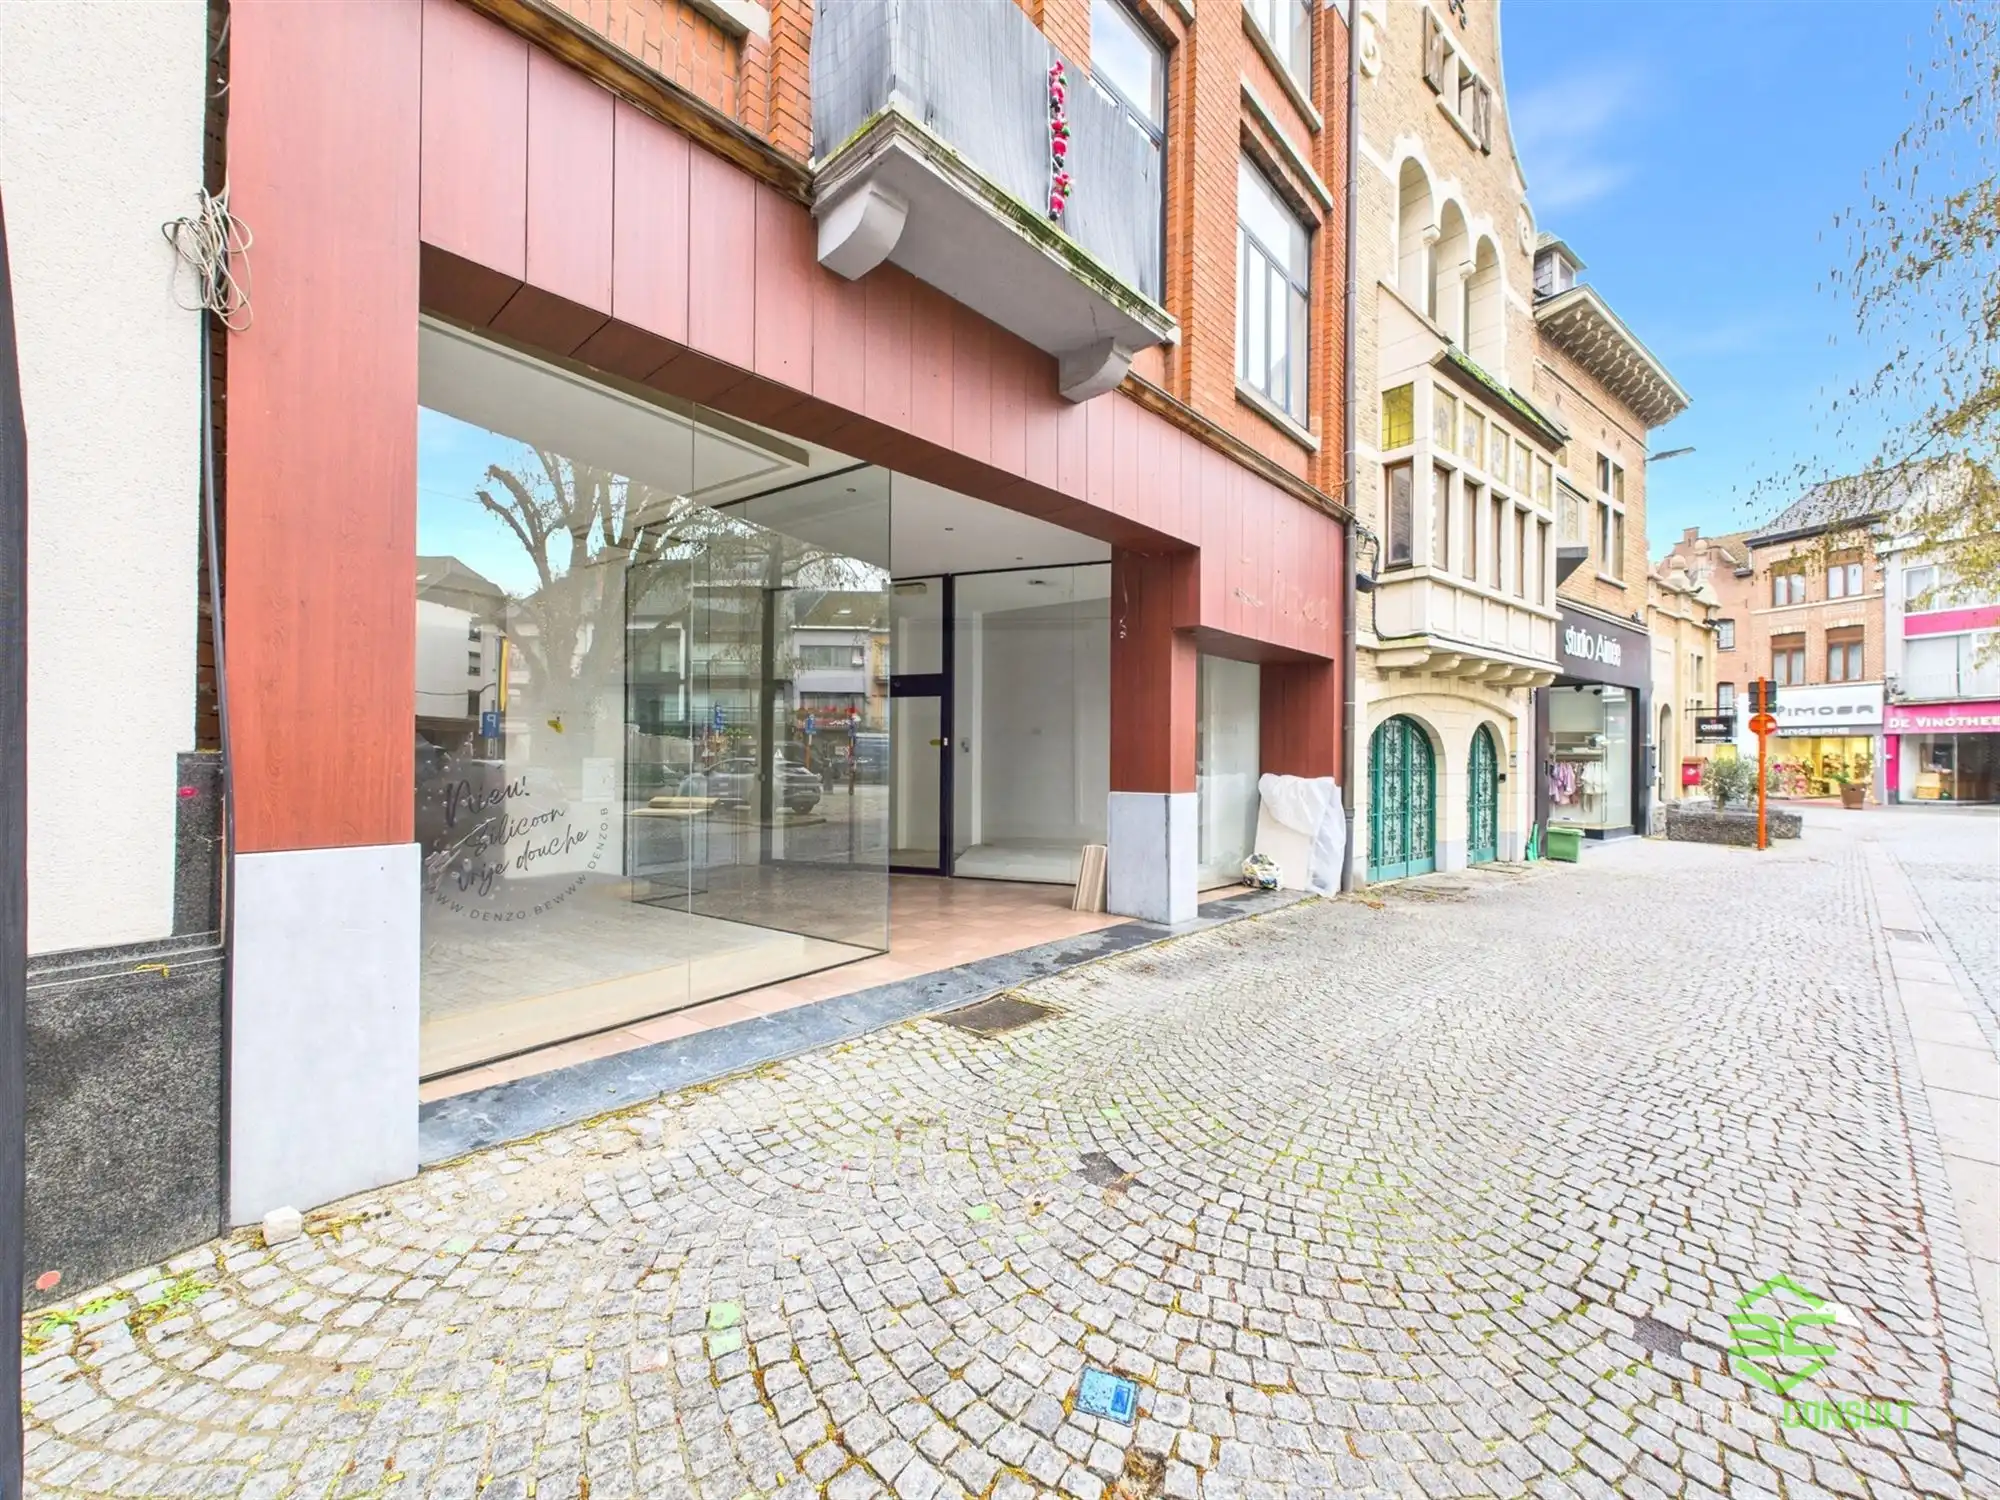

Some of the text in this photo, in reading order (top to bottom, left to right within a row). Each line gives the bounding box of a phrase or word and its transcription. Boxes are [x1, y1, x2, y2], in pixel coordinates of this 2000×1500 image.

[1565, 625, 1595, 659] studio
[1888, 717, 1911, 728] DE
[516, 823, 589, 872] douche
